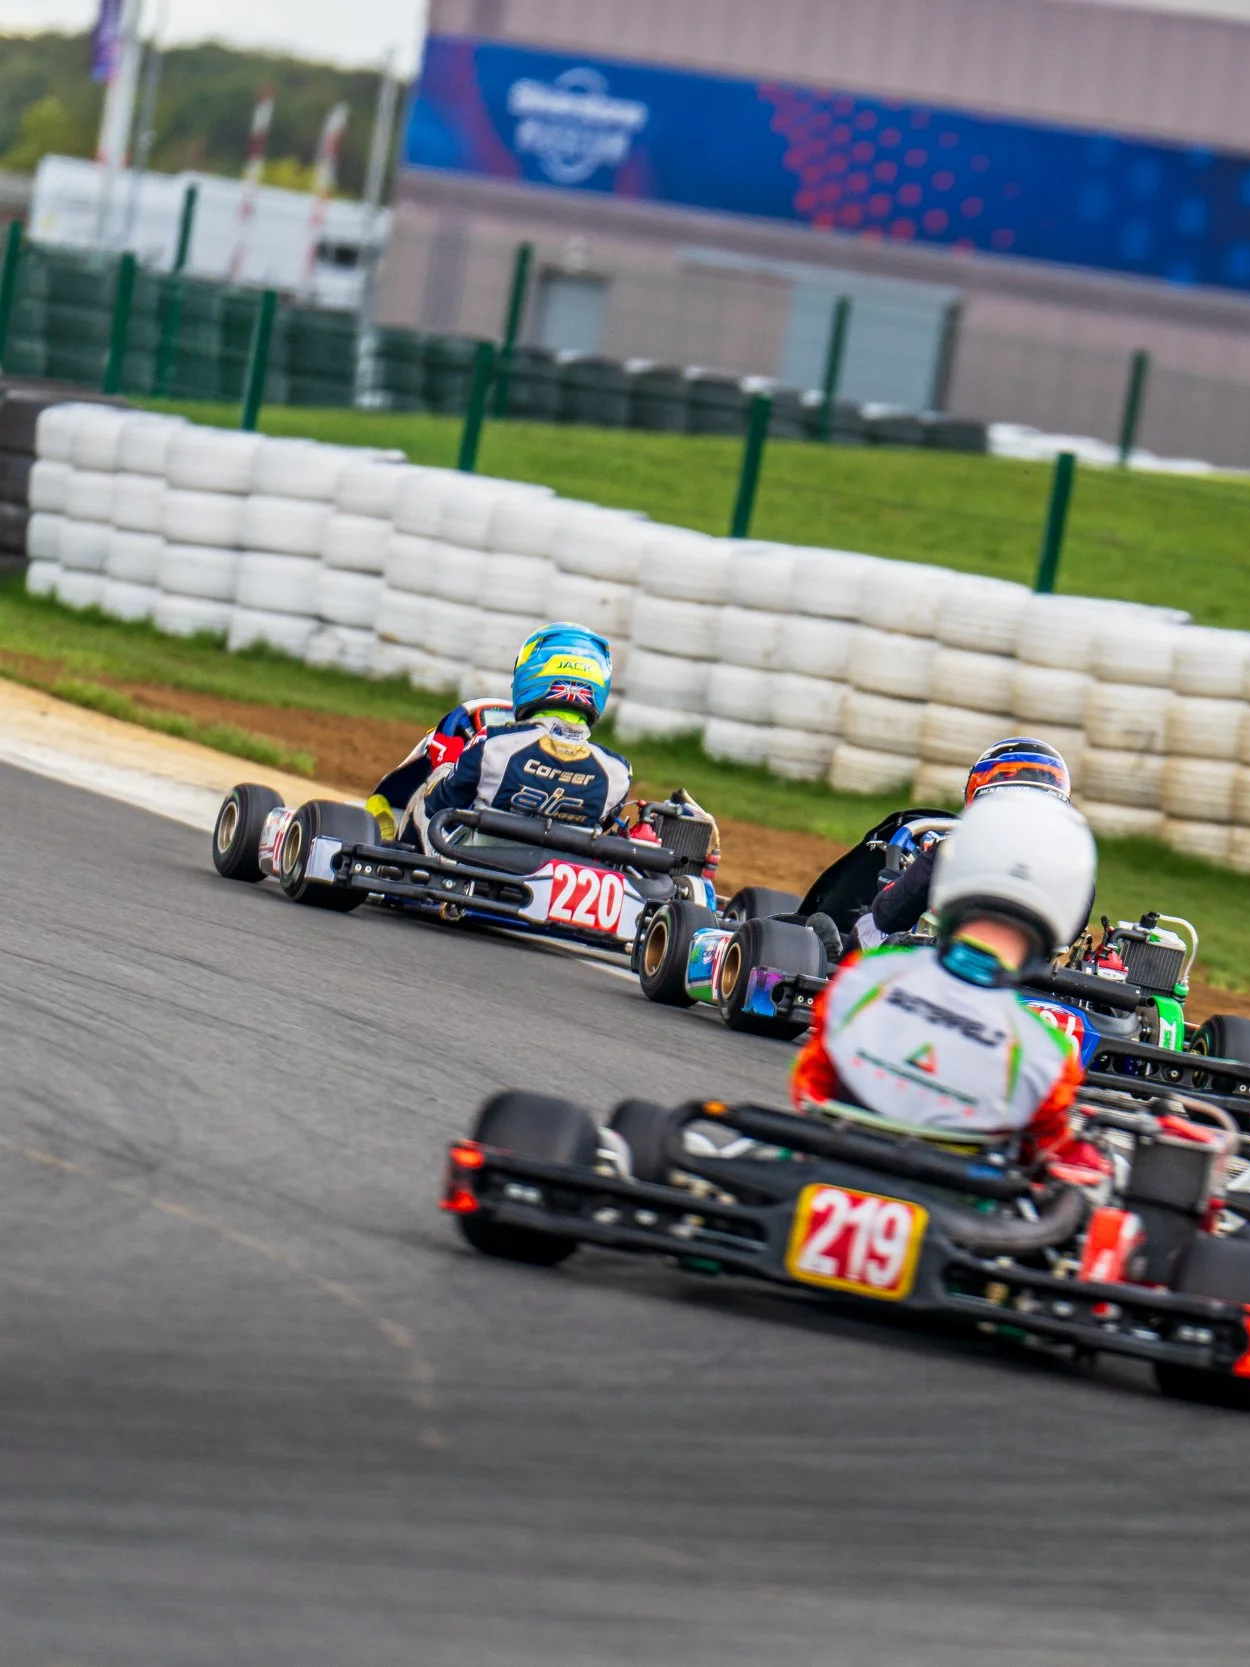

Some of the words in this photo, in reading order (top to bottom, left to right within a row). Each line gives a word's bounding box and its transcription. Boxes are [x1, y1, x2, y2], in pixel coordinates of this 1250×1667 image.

[556, 660, 593, 673] JACK
[523, 758, 596, 786] Corser
[549, 863, 623, 931] 220
[800, 1187, 912, 1289] 219
